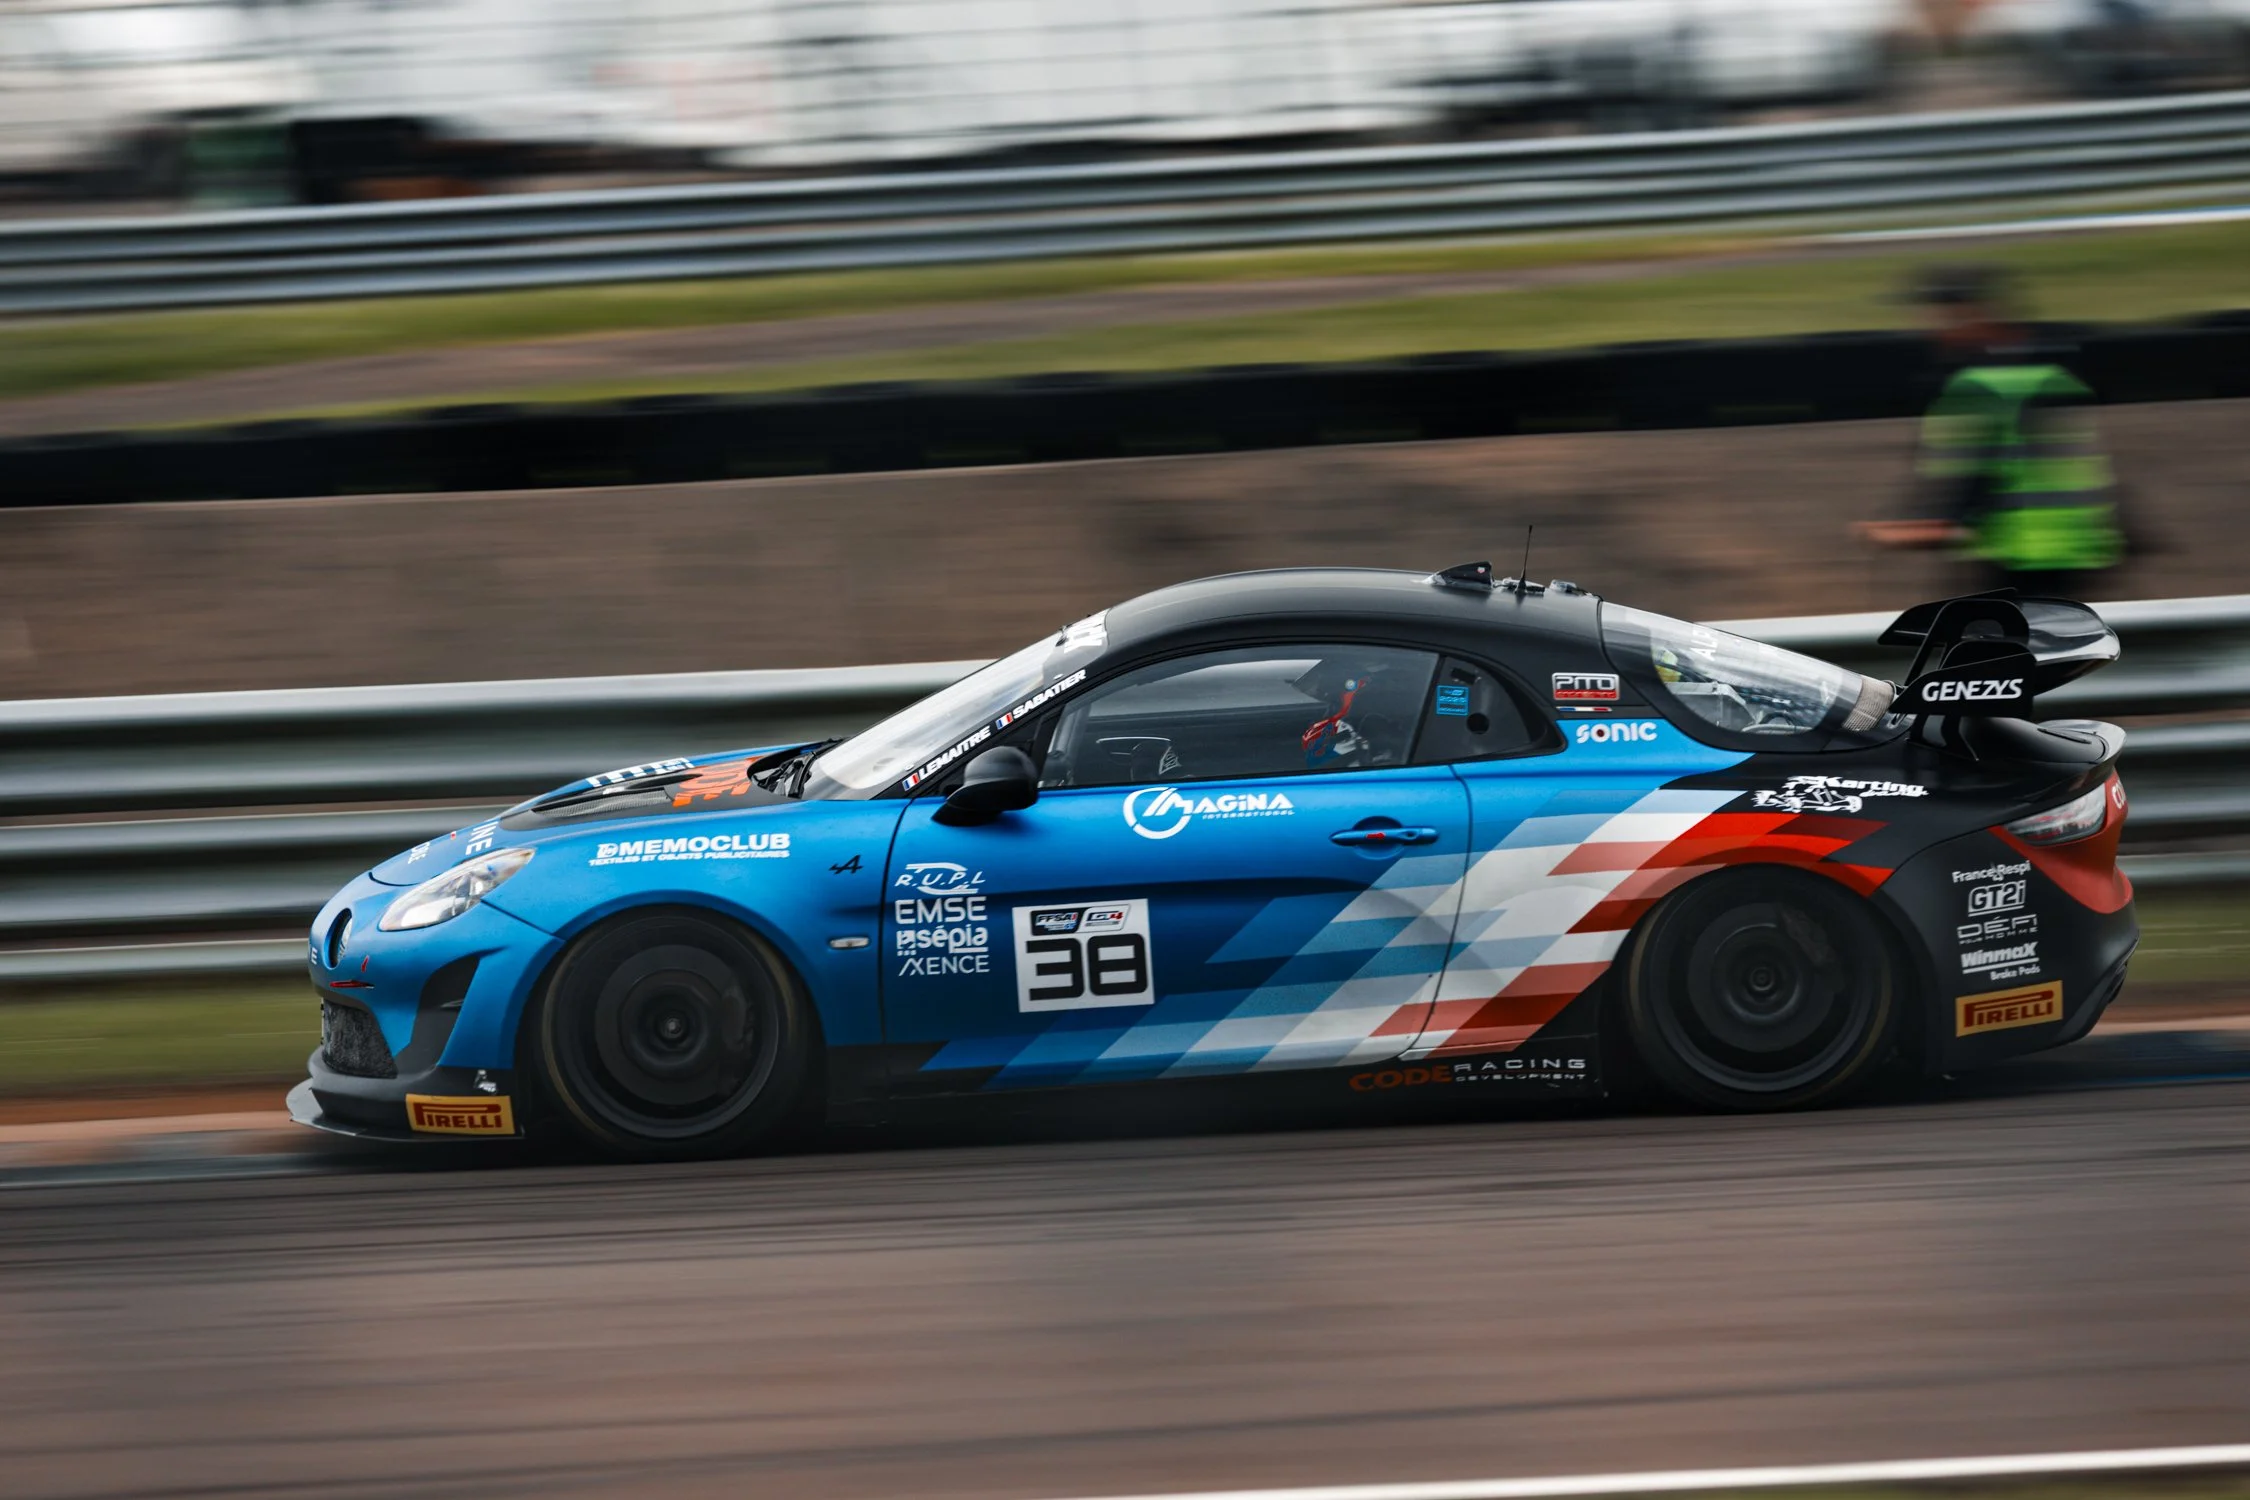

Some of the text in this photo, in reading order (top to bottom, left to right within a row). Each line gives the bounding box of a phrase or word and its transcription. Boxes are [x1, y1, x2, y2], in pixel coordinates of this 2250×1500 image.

[1012, 668, 1087, 721] SABATIER
[1921, 677, 2024, 702] GENEZYS
[919, 725, 991, 781] LEMAITRE
[619, 832, 791, 857] MEMOCLUB
[641, 852, 657, 863] ET
[895, 896, 988, 925] EMSE
[916, 923, 989, 954] sépia
[1026, 933, 1149, 1002] 38
[1963, 990, 2054, 1028] PIRELLI
[1349, 1058, 1588, 1092] CODE RACING
[1455, 1073, 1588, 1083] DEVELOPMENT
[412, 1102, 502, 1129] PIRELLI
